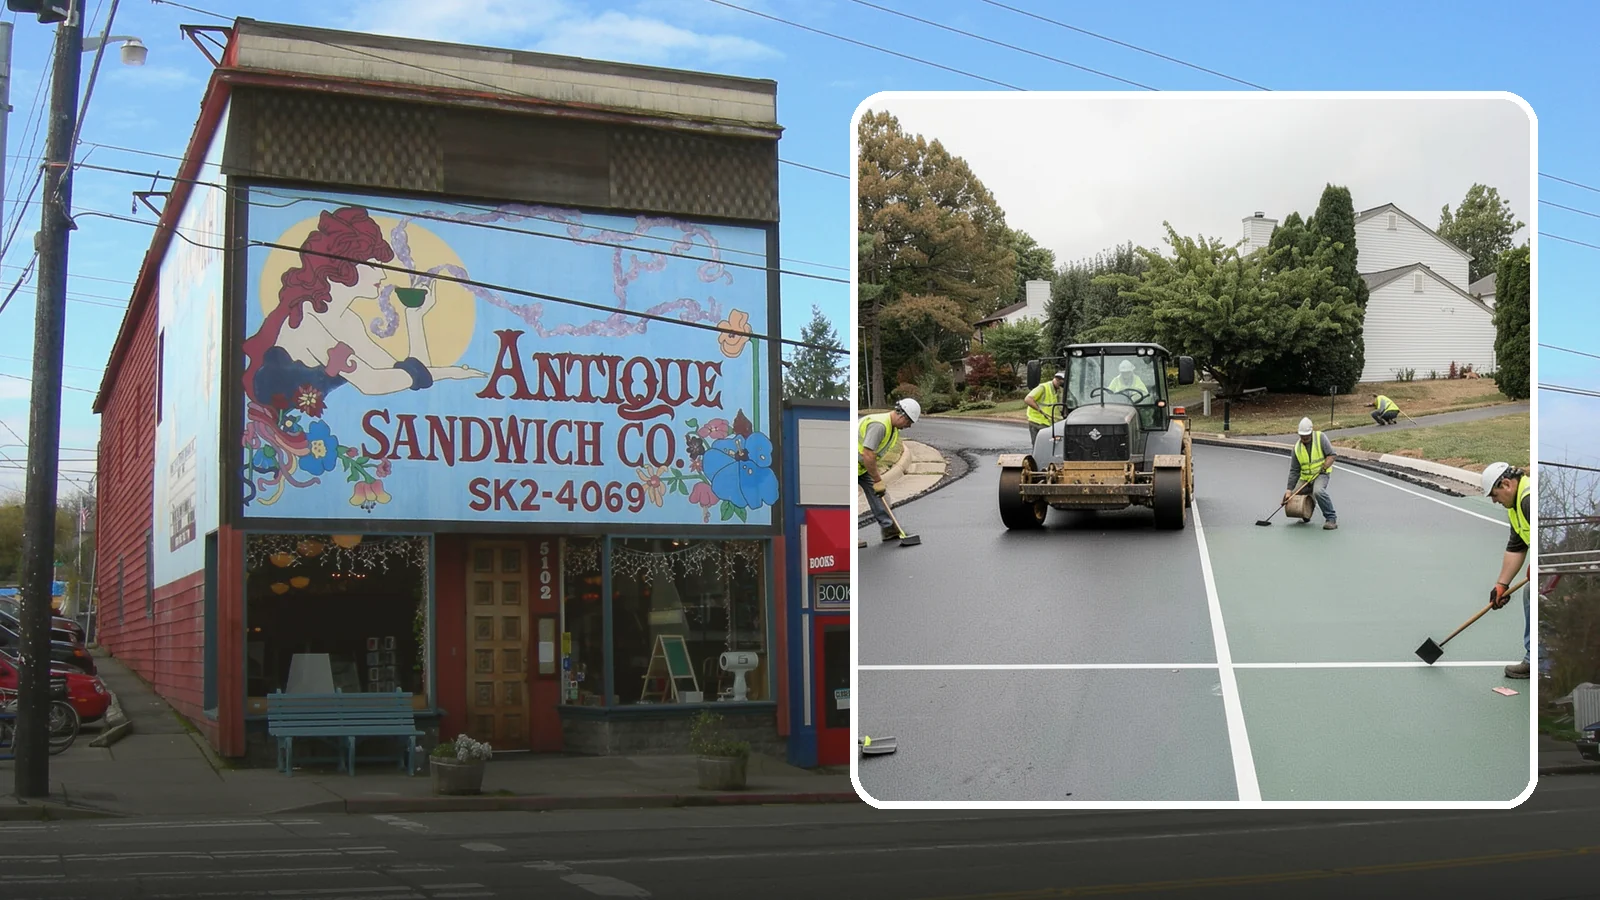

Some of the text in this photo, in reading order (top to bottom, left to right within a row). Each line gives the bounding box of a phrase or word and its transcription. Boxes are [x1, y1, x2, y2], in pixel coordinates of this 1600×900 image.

[476, 329, 724, 420] ANTIQUE
[362, 408, 686, 469] SANDWICH CO.
[469, 477, 646, 513] SK2-4069
[540, 541, 551, 600] 5102
[809, 555, 835, 569] BOOKS
